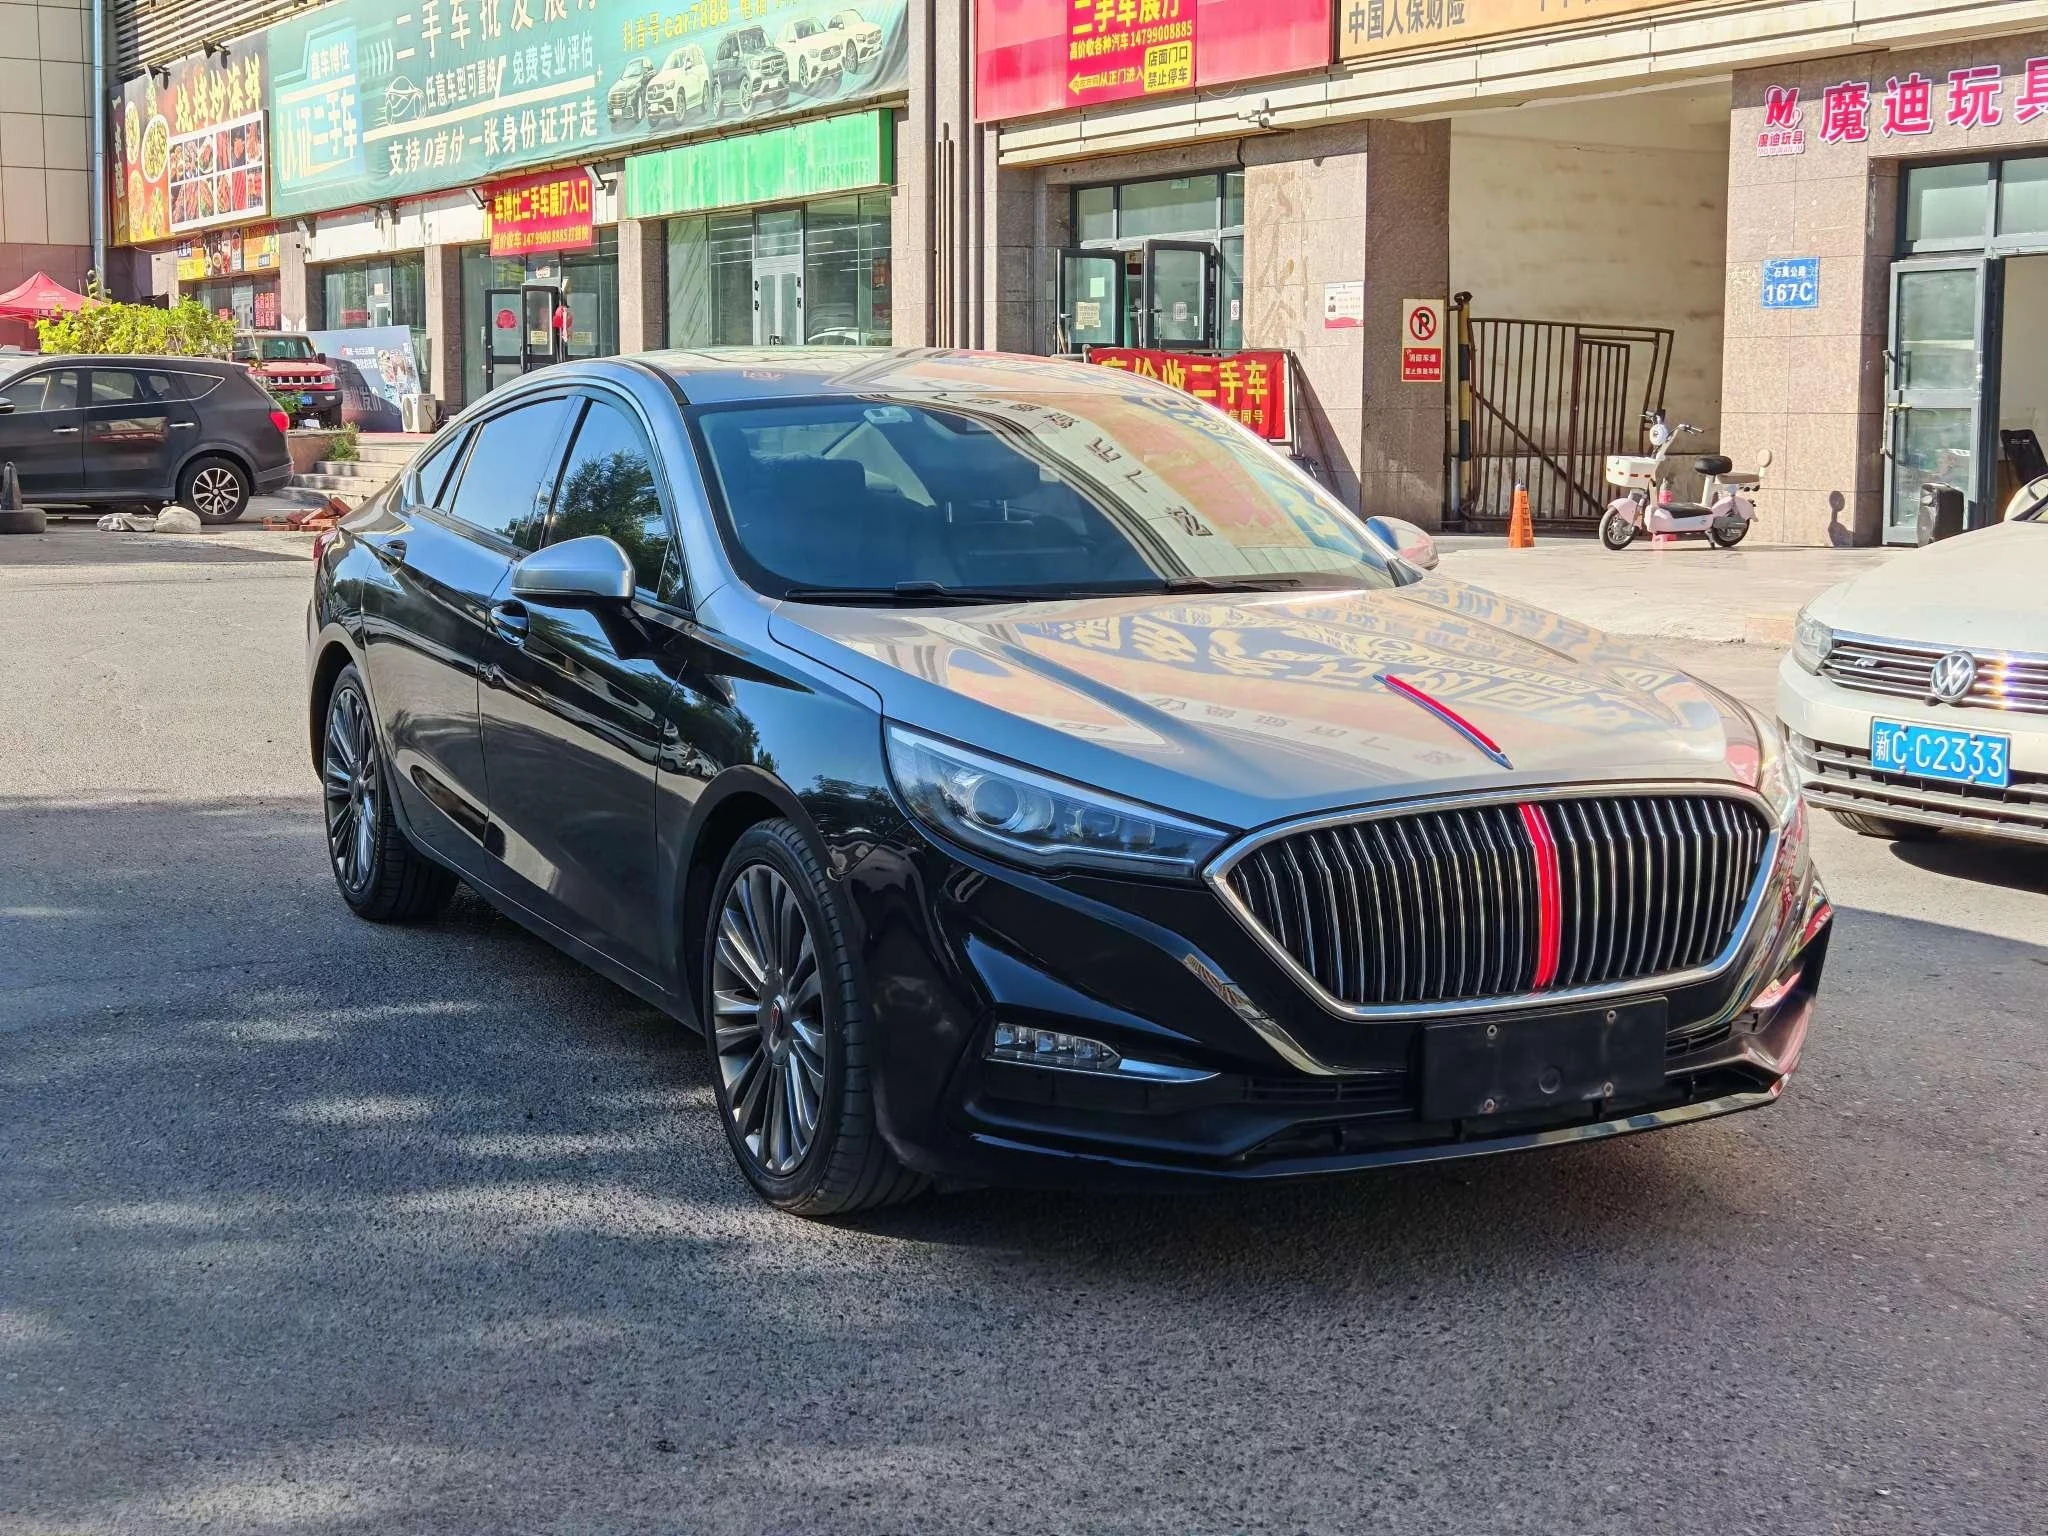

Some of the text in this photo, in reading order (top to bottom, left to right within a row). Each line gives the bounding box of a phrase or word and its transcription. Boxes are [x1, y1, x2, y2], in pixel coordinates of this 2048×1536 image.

[396, 0, 599, 60] 二手车批发
[623, 10, 660, 52] 抖音号
[1069, 19, 1193, 61] 高价收各种汽车 14799008885
[1348, 0, 1465, 44] 中国人保财险
[425, 30, 593, 109] 任意车型可置换 免费专业评估
[1147, 66, 1188, 88] 禁止停车
[1148, 45, 1188, 67] 店面门口
[1818, 56, 2048, 145] 魔迪玩具
[279, 88, 358, 182] 认证二手车
[494, 178, 589, 224] 车博仕二手车展厅入口
[1765, 282, 1812, 304] 167C
[1101, 355, 1268, 404] 收二手车
